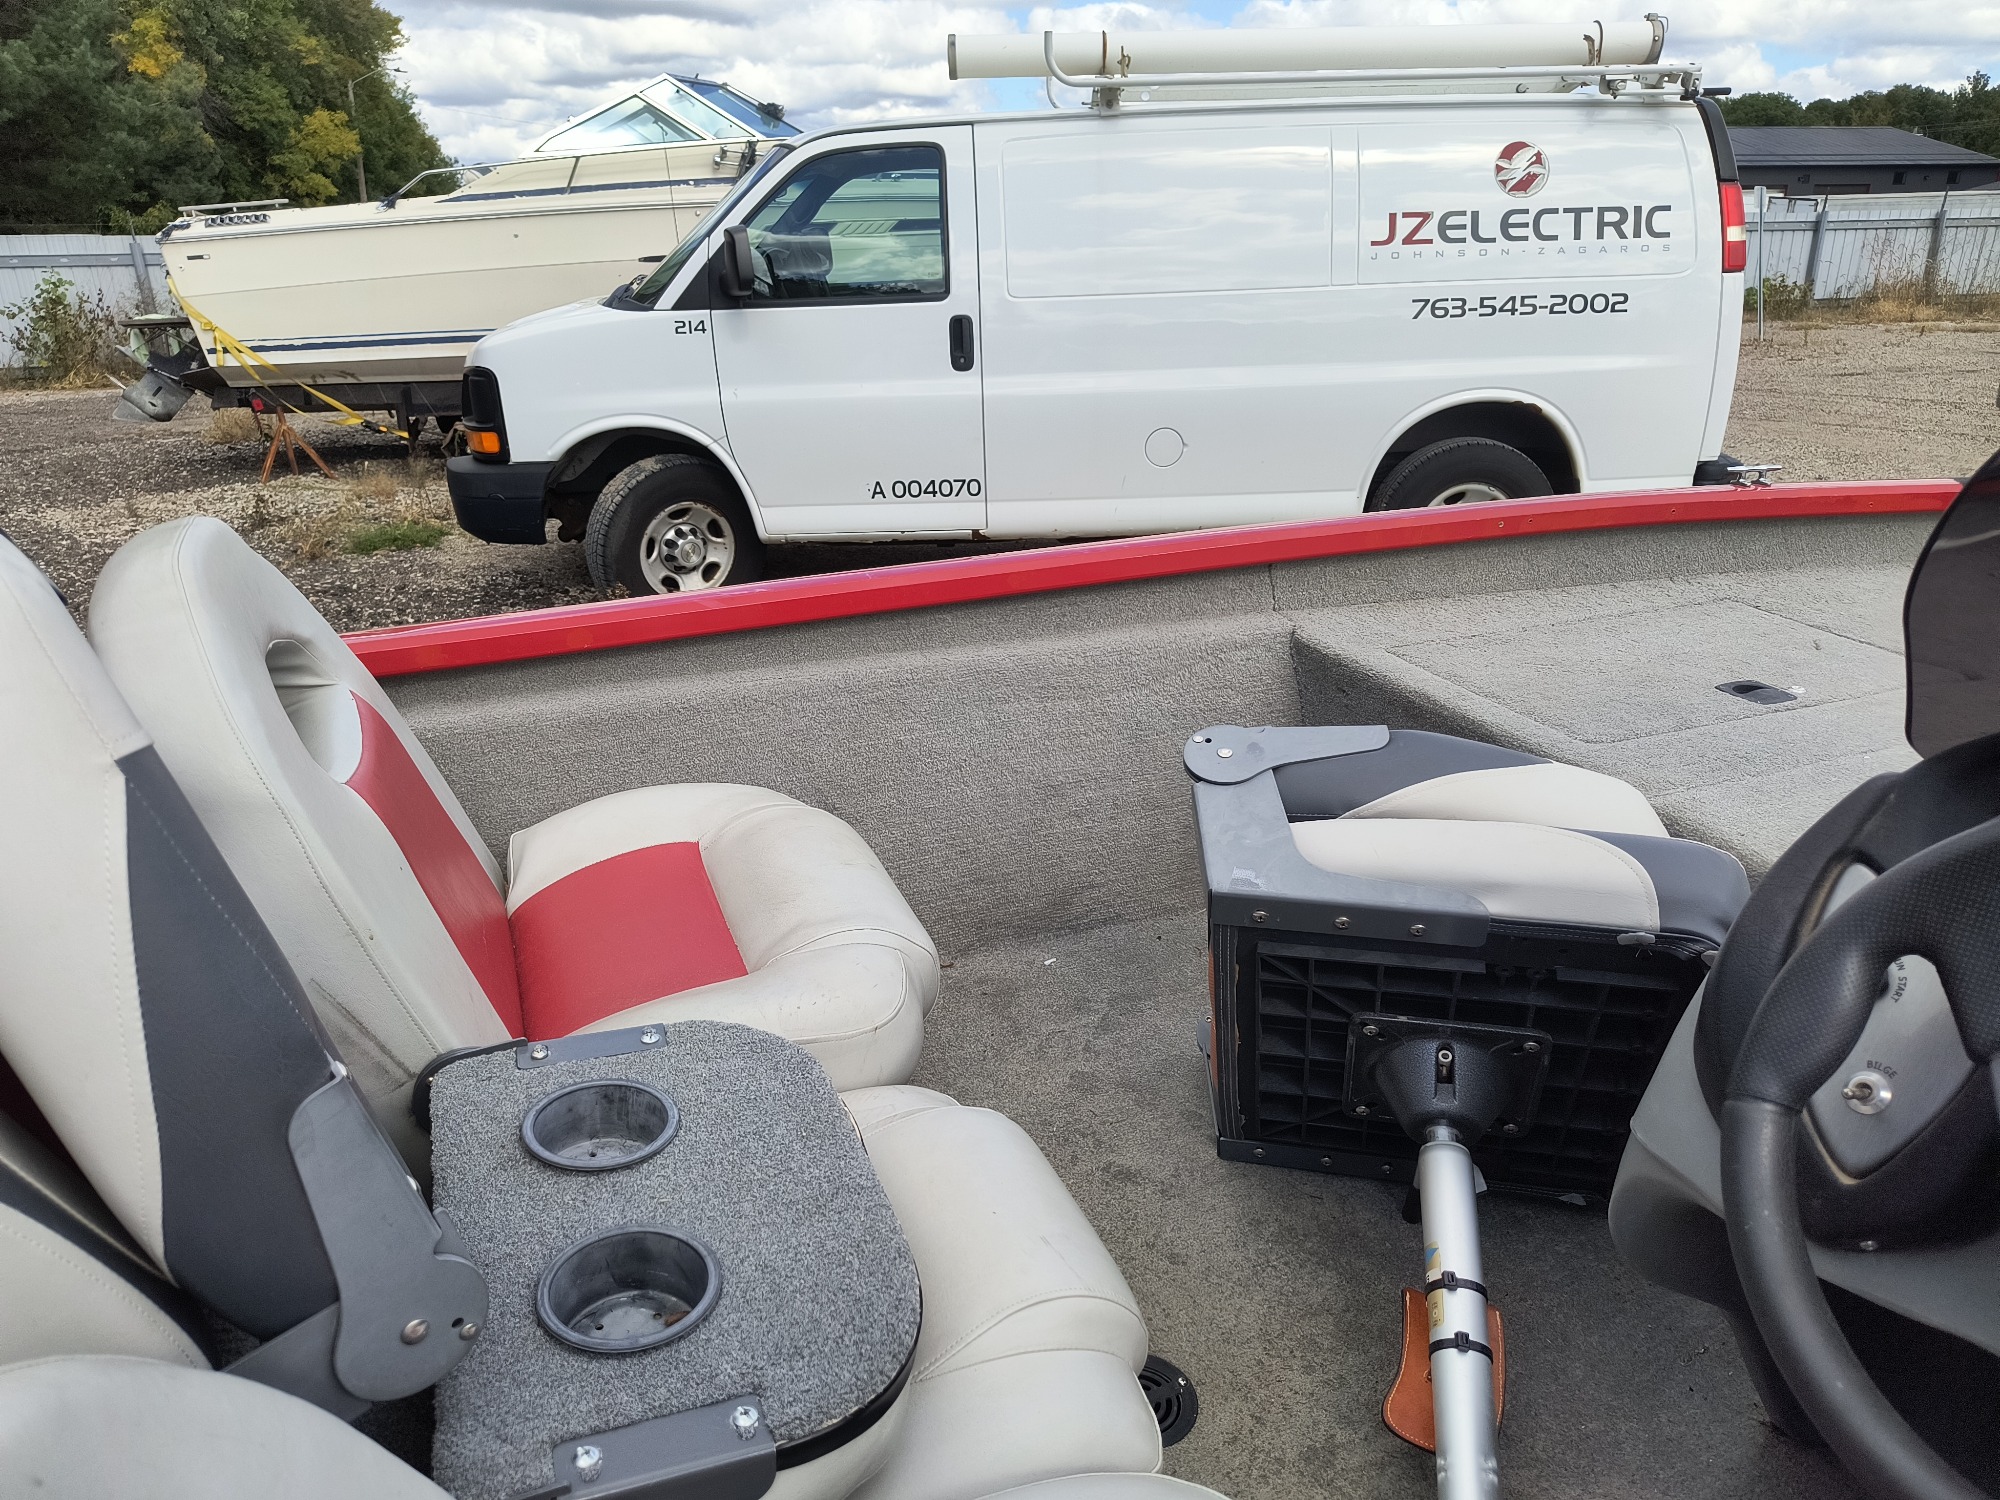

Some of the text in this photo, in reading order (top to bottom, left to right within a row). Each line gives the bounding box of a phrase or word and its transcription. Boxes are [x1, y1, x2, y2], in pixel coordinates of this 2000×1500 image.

[1411, 293, 1629, 320] 763-545-2002
[674, 320, 707, 334] 214
[871, 479, 981, 499] A 004070
[1891, 976, 1907, 1003] START
[1866, 1060, 1898, 1079] BILGE
